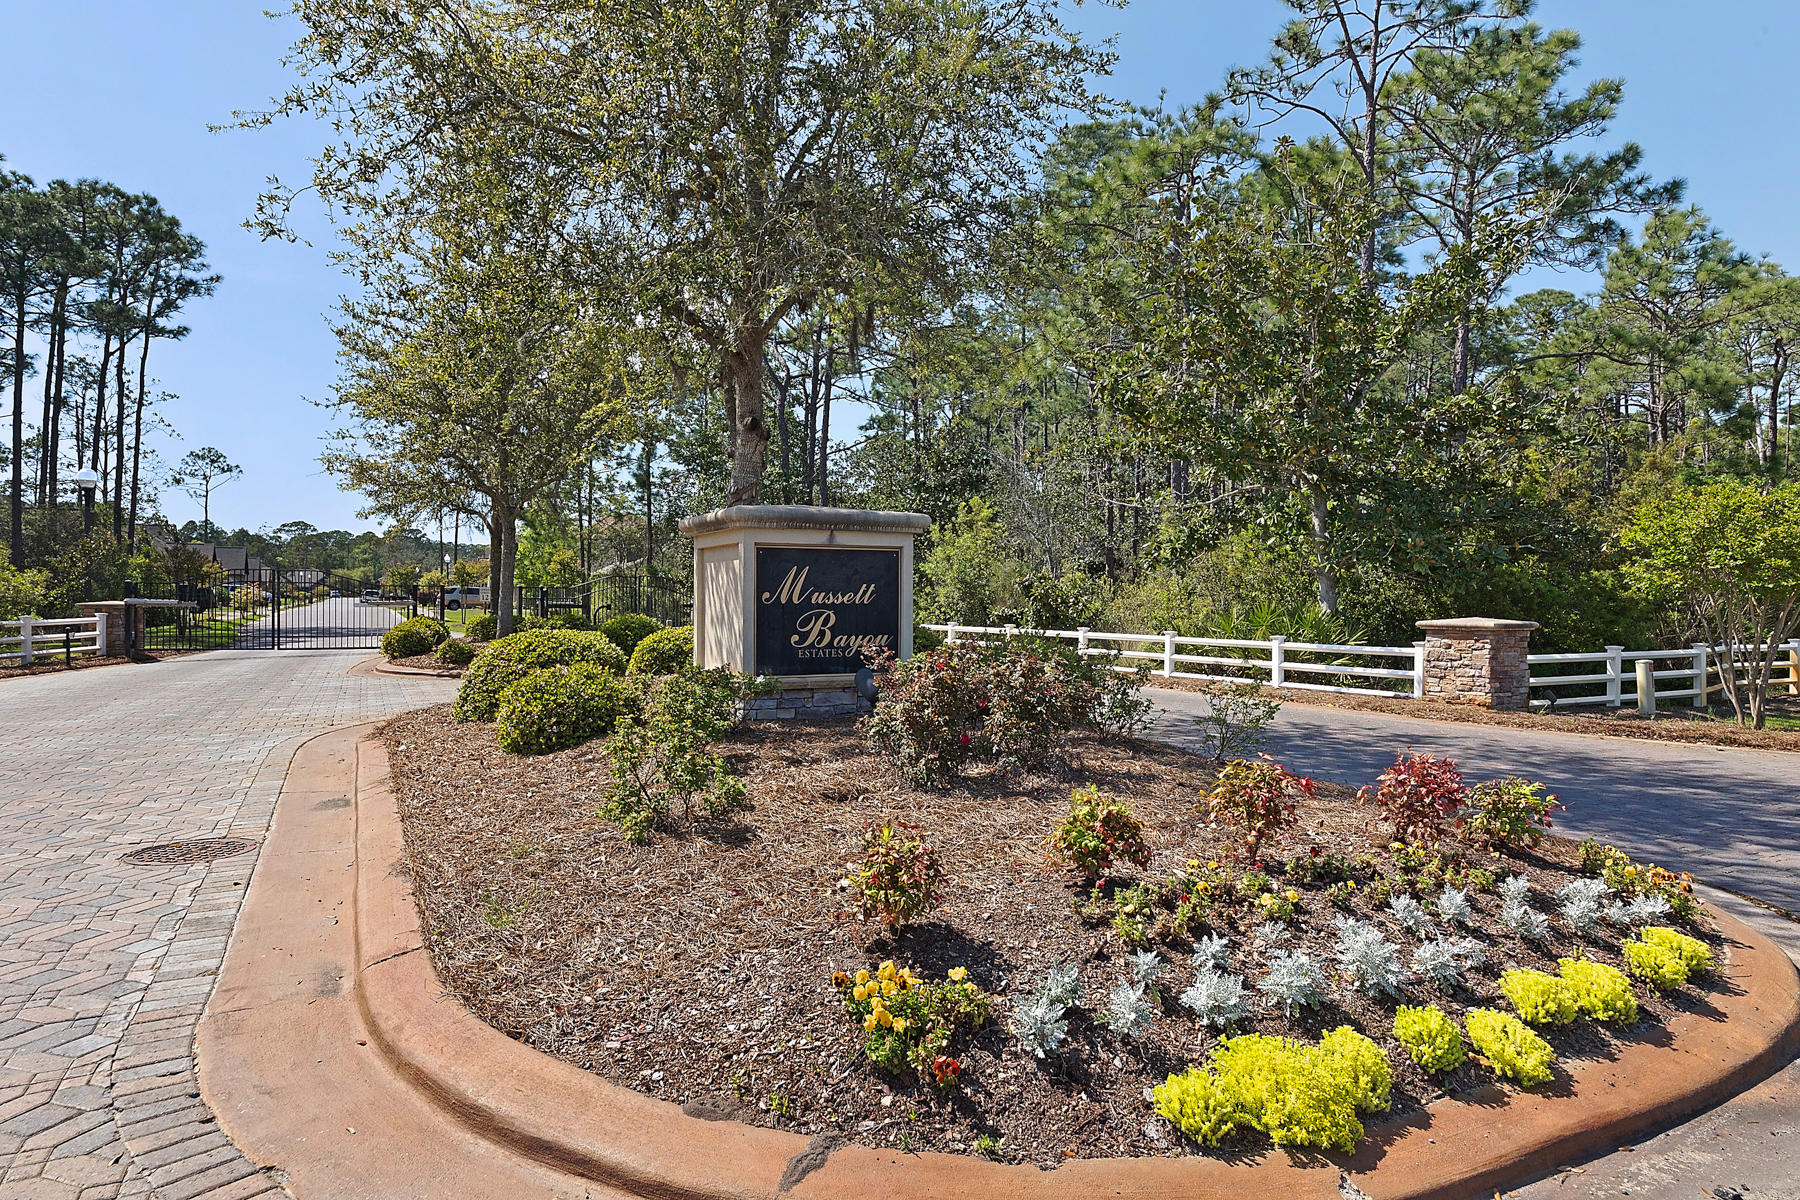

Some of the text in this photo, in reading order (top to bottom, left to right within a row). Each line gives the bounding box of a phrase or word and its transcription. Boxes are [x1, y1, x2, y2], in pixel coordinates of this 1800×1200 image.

[762, 565, 877, 604] Mussett
[790, 609, 894, 657] Bayou
[798, 649, 843, 657] ESTATES
